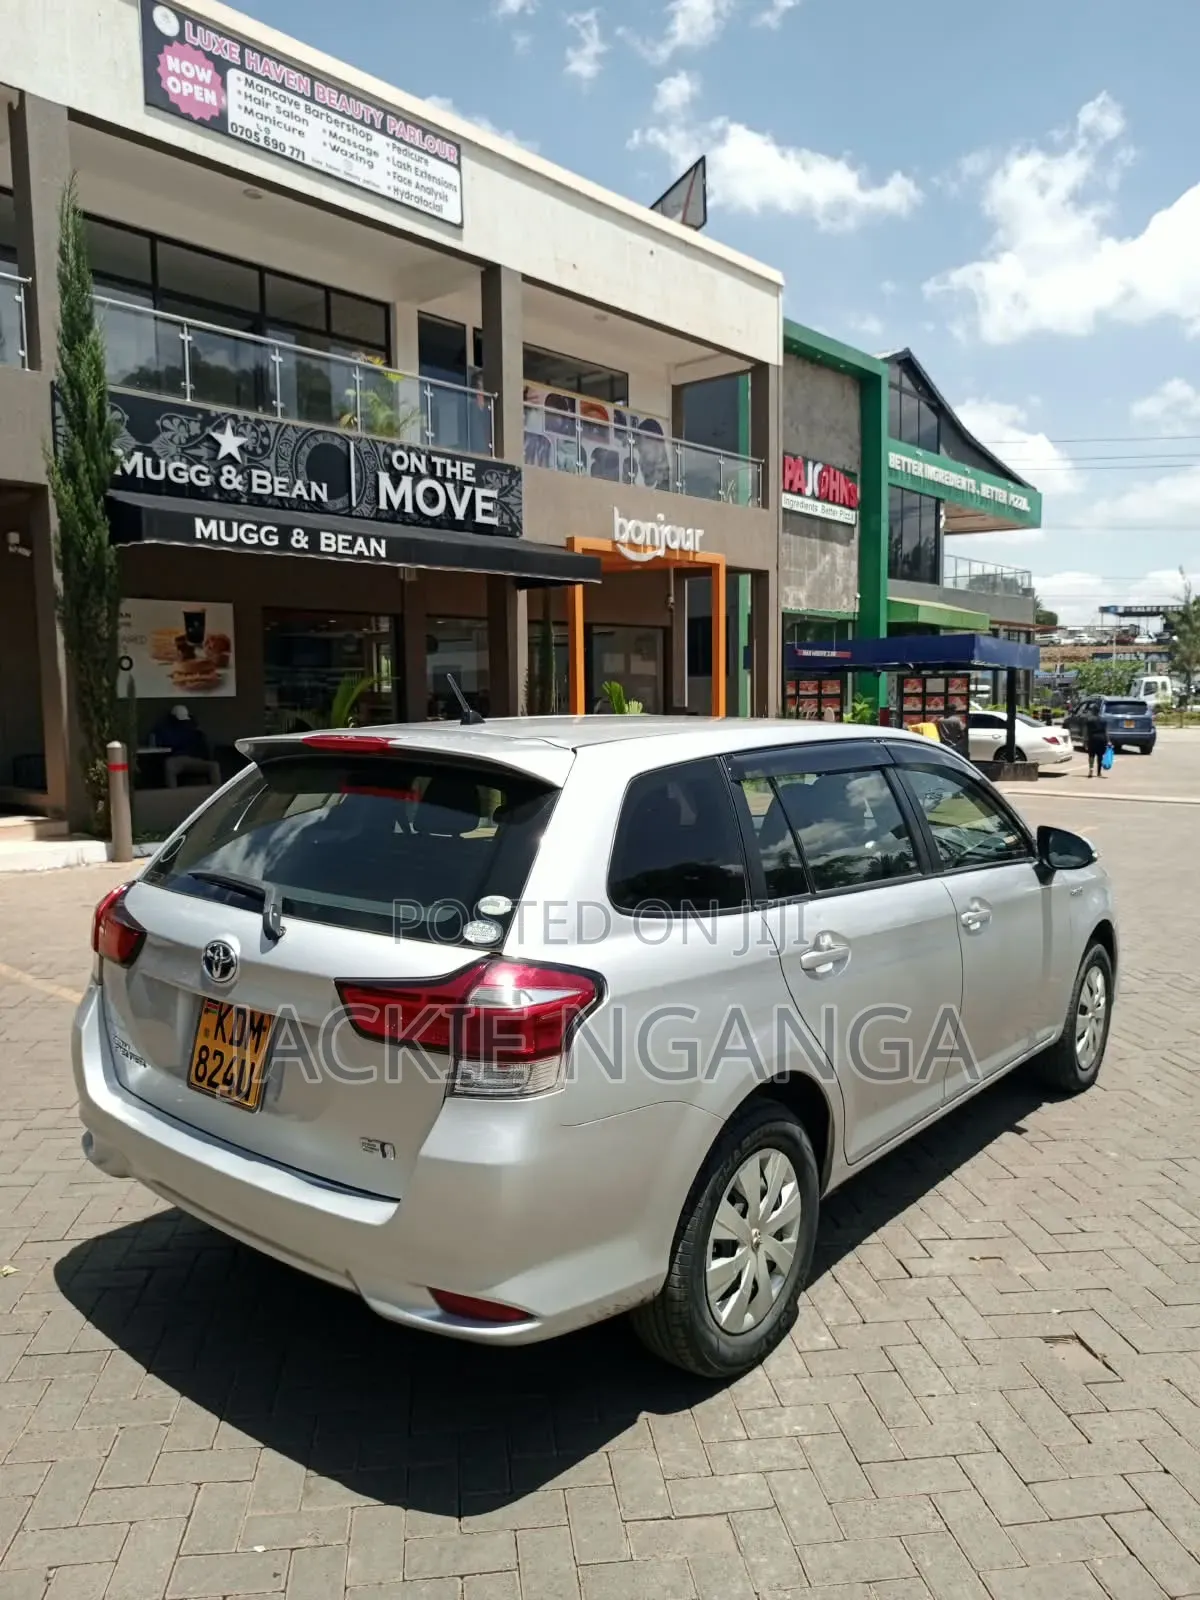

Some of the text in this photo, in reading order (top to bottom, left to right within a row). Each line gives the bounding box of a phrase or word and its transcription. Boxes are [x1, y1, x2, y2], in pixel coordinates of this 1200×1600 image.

[166, 54, 213, 85] NOW
[166, 76, 217, 107] OPEN
[184, 20, 458, 164] LUXE HAVEN BEAUTY PARLOUR
[243, 91, 271, 110] Hair
[244, 76, 373, 142] Mancave Barbershop
[243, 105, 305, 138] Manicure
[230, 121, 306, 162] 0705 690 771
[328, 129, 380, 159] Massage
[328, 141, 375, 170] Waxing
[391, 142, 430, 167] Pedicure
[391, 156, 413, 174] Lash
[414, 166, 458, 193] Extensions
[392, 171, 413, 188] Face
[114, 450, 329, 503] MUGG & BEAN
[391, 450, 477, 484] ON THE
[376, 471, 500, 528] MOVE
[194, 517, 387, 559] MUGG & BEAN
[613, 506, 704, 562] bonjour
[213, 1002, 266, 1054] KDM
